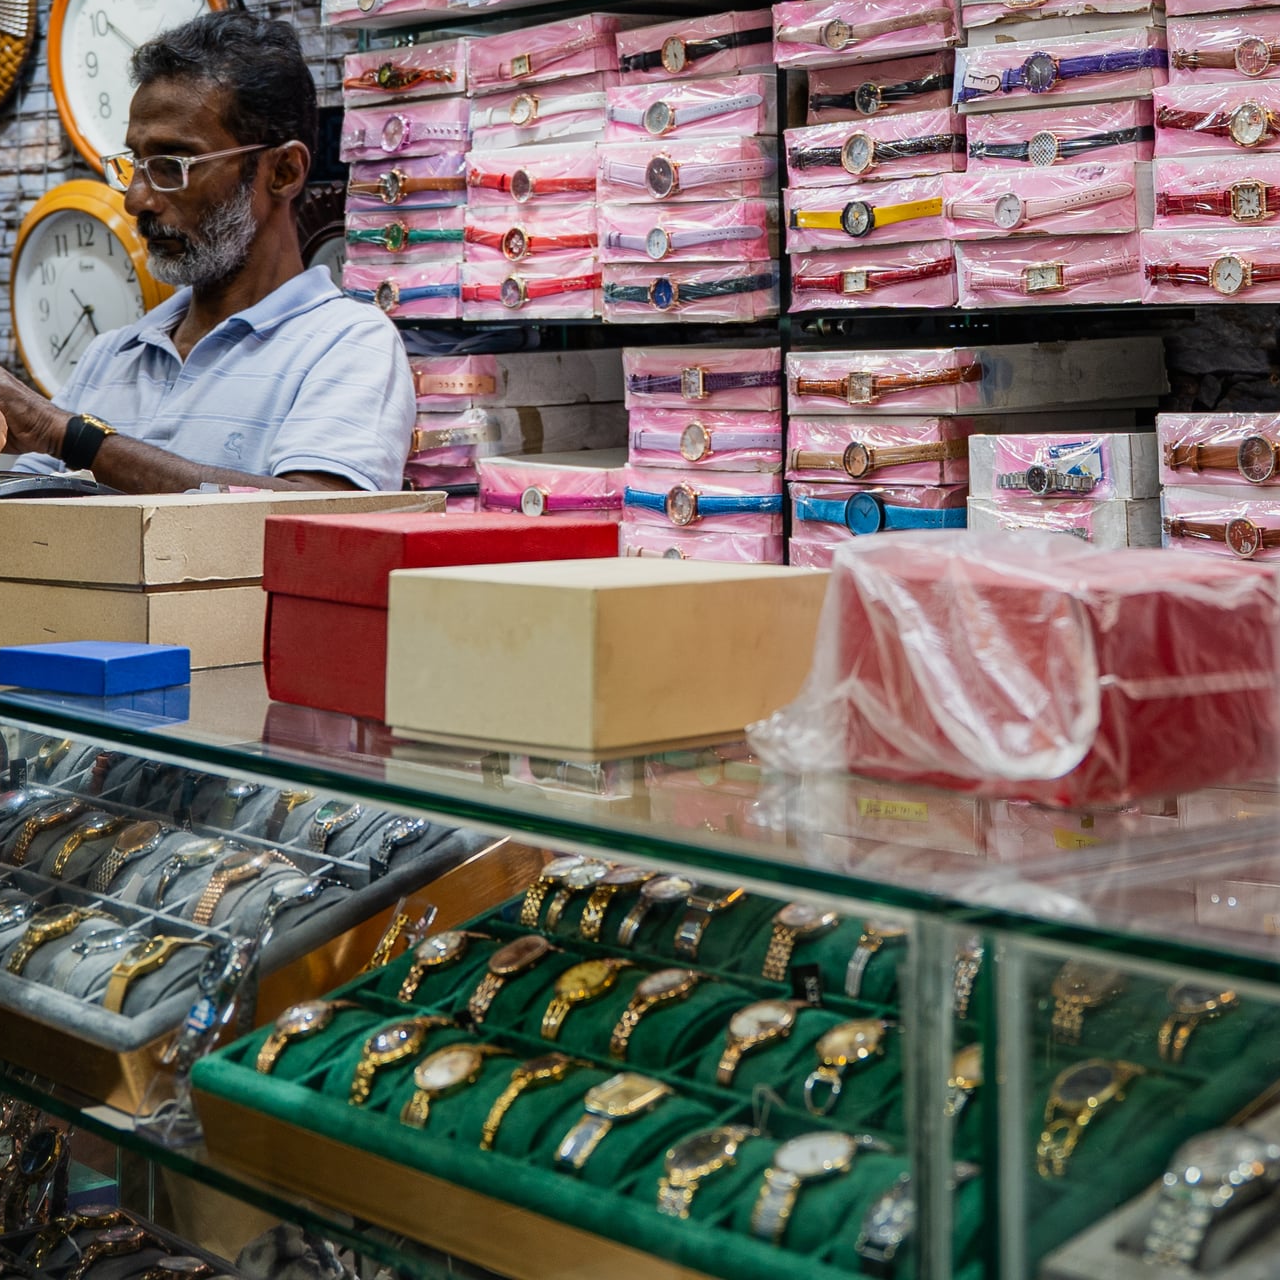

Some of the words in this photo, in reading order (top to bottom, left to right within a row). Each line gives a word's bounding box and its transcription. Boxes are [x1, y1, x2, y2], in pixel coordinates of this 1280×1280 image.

[90, 10, 109, 37] 10
[85, 51, 98, 78] 9
[99, 92, 112, 119] 8
